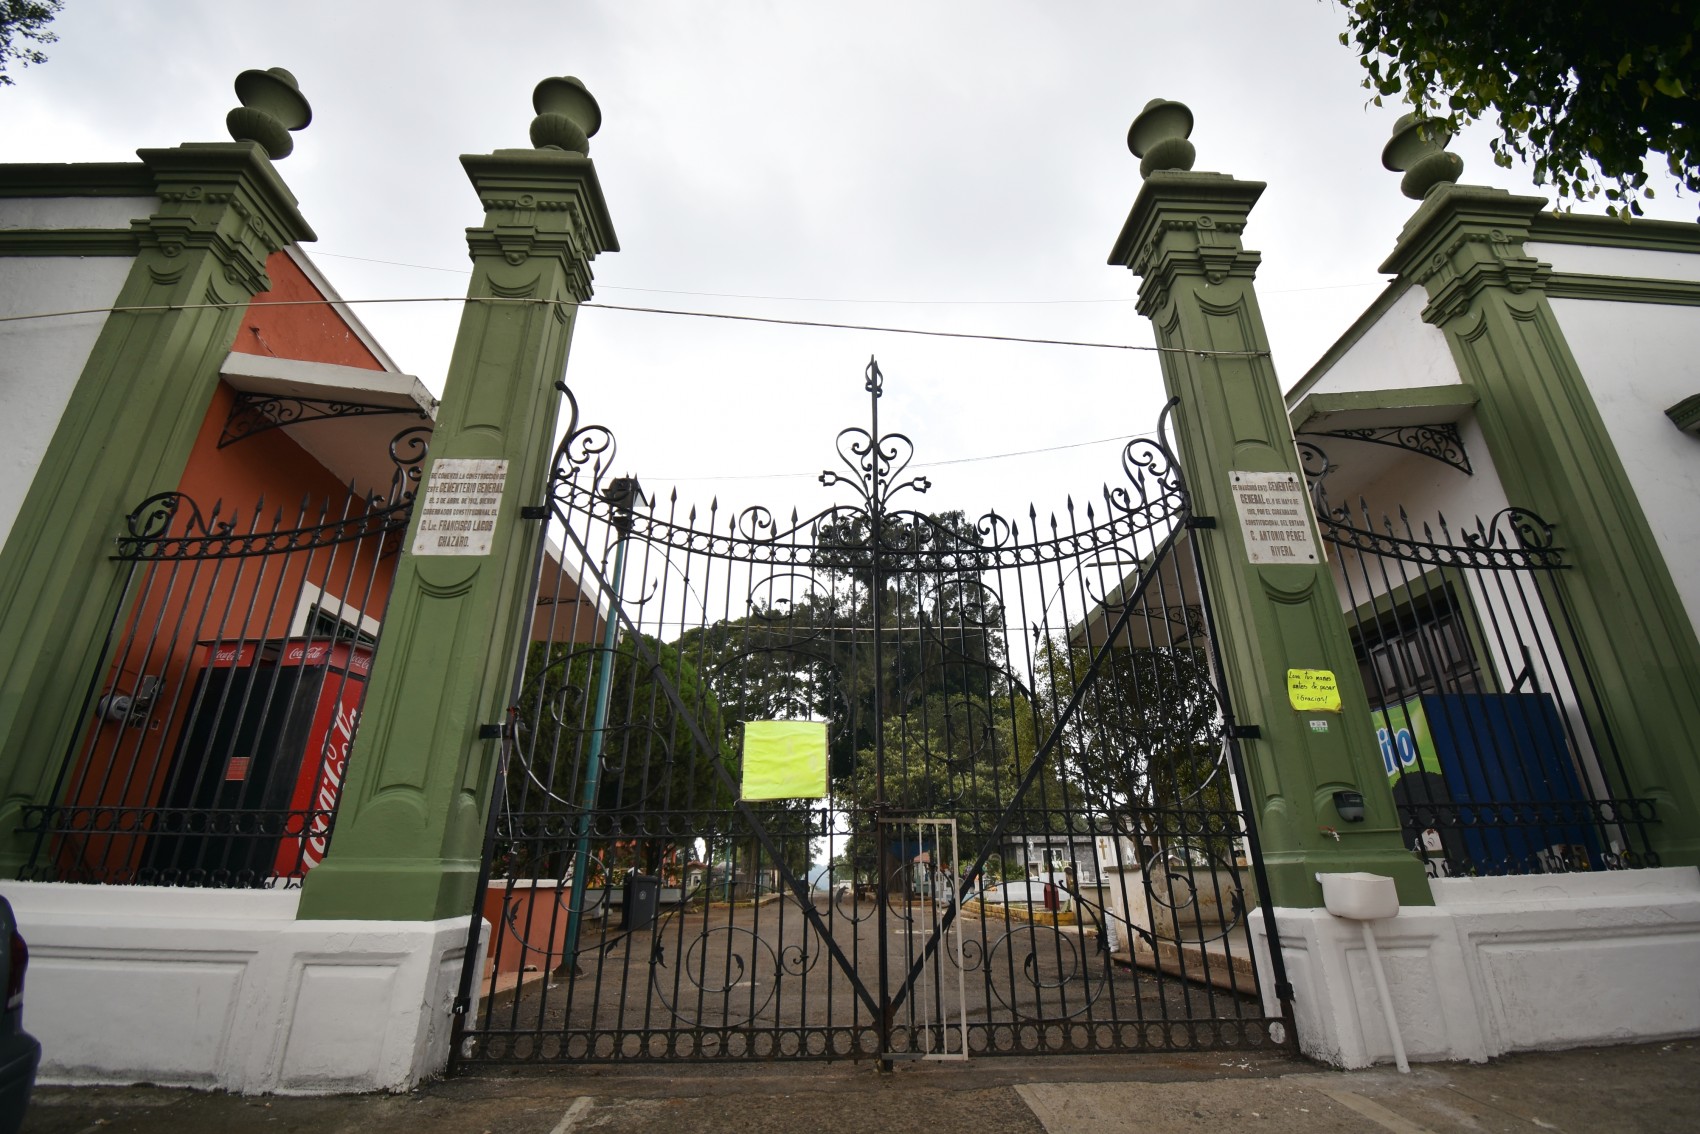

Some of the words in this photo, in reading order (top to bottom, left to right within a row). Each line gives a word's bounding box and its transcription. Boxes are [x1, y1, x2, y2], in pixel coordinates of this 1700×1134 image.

[439, 482, 477, 493] CEMENTERIO
[477, 482, 504, 493] GENERAL
[1240, 493, 1266, 505] GENERAL
[438, 520, 472, 531] FRANCISCO
[472, 520, 494, 531] LAGOS
[1259, 530, 1285, 541] ANTONIO
